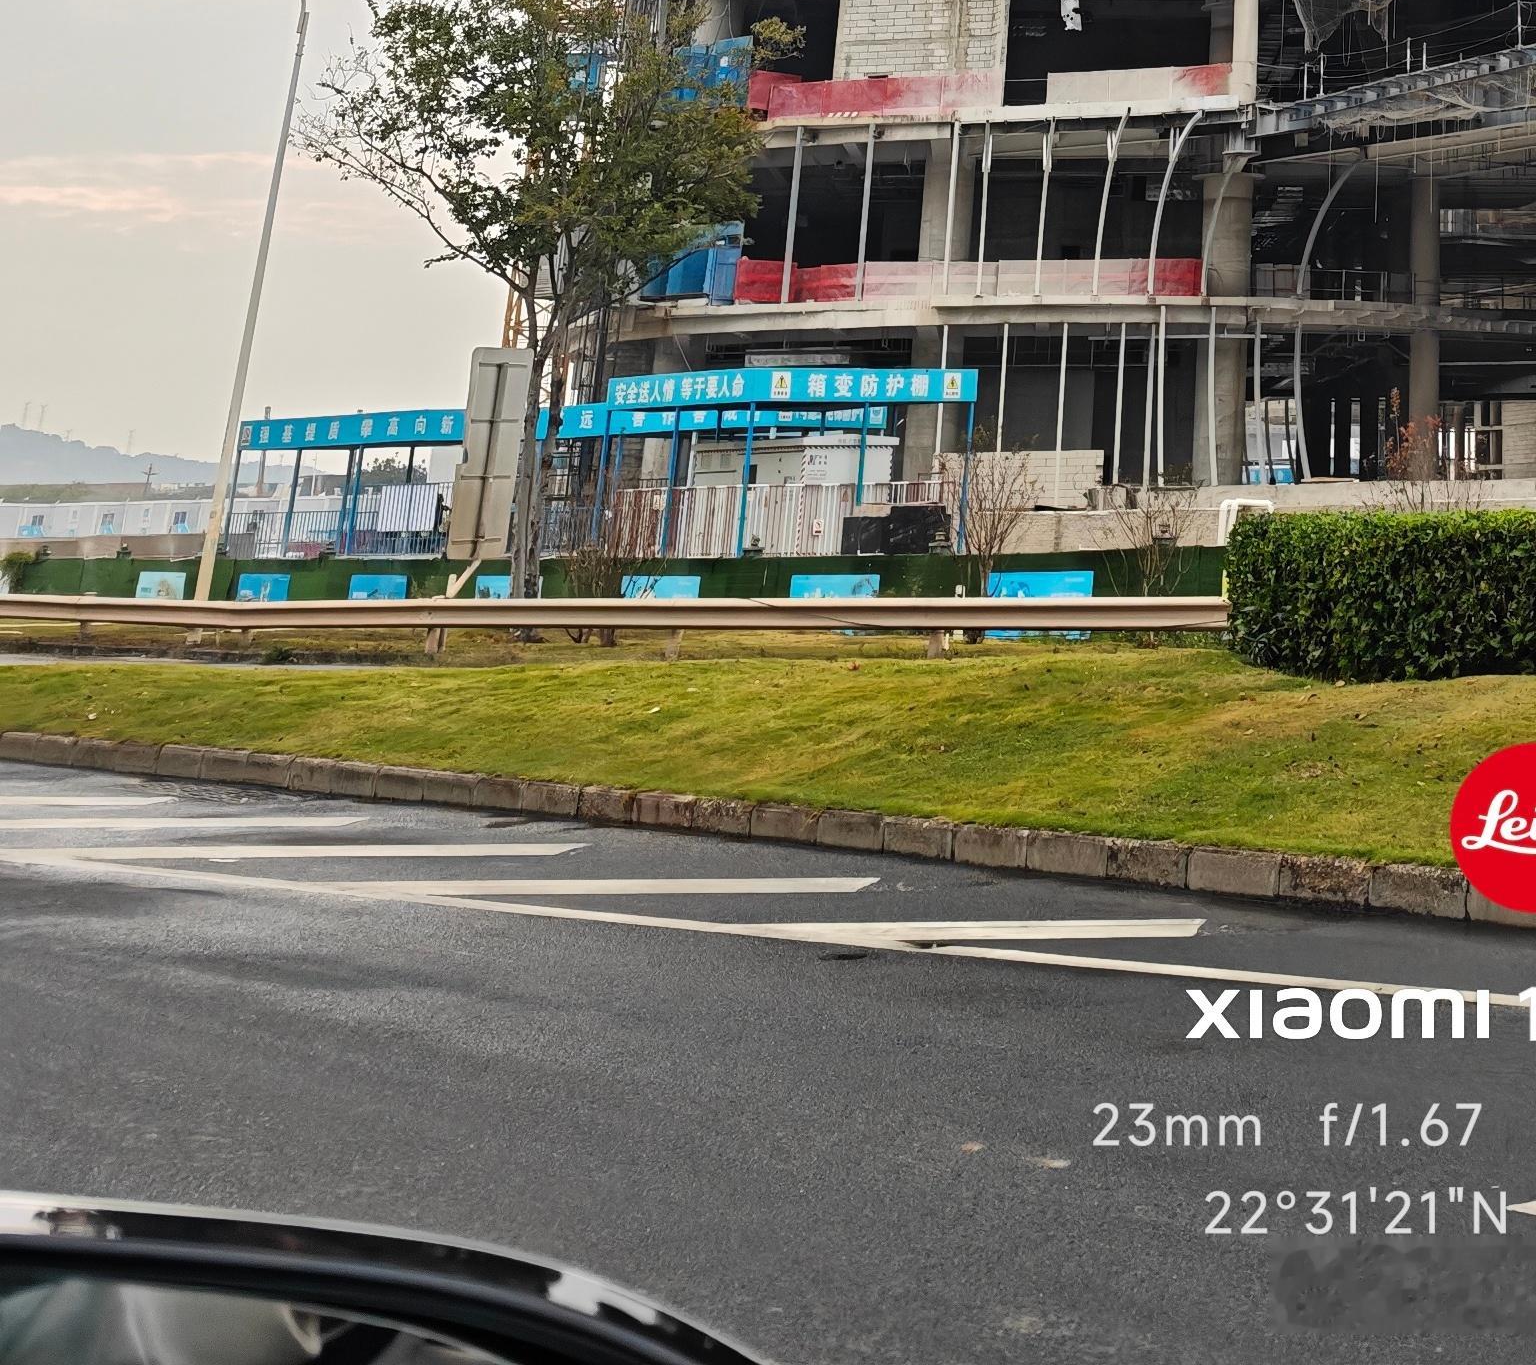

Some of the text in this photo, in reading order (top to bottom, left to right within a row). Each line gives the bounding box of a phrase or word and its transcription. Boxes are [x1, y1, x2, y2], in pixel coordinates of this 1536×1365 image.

[807, 373, 930, 398] 箱变防护棚
